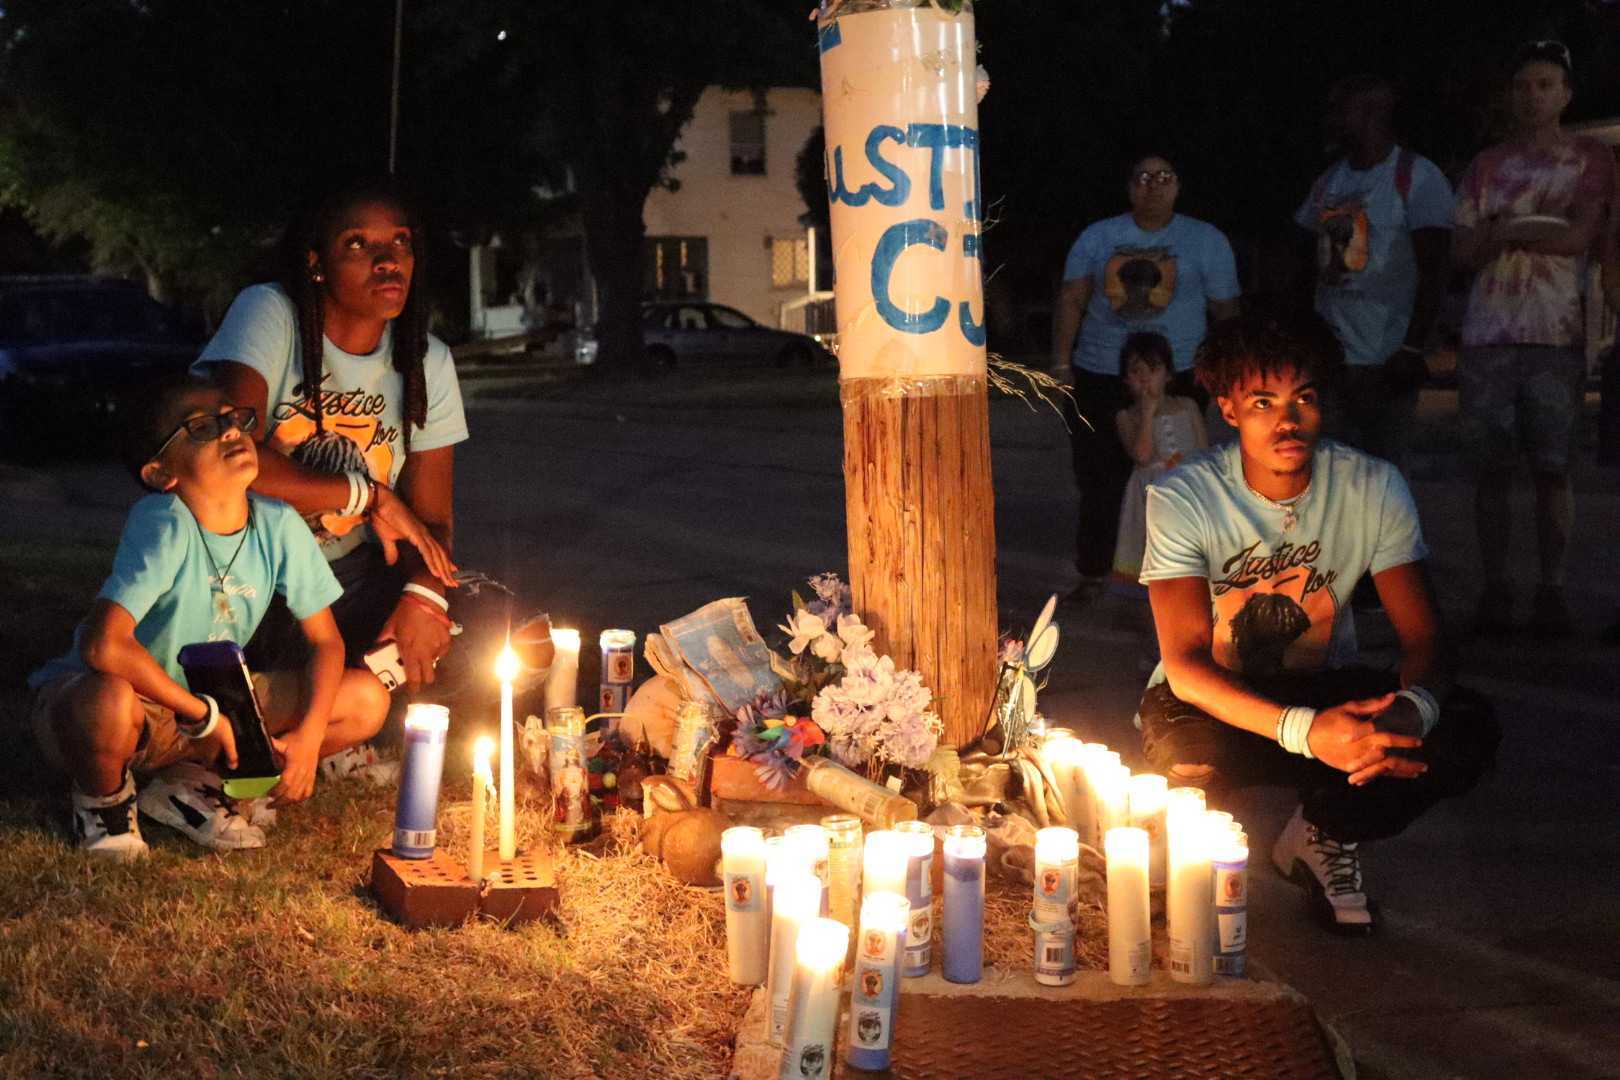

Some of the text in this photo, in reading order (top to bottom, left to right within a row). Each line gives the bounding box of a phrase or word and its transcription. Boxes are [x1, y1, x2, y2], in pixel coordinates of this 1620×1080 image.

[365, 421, 399, 452] for
[1212, 540, 1322, 596] Justice
[1300, 567, 1338, 603] for
